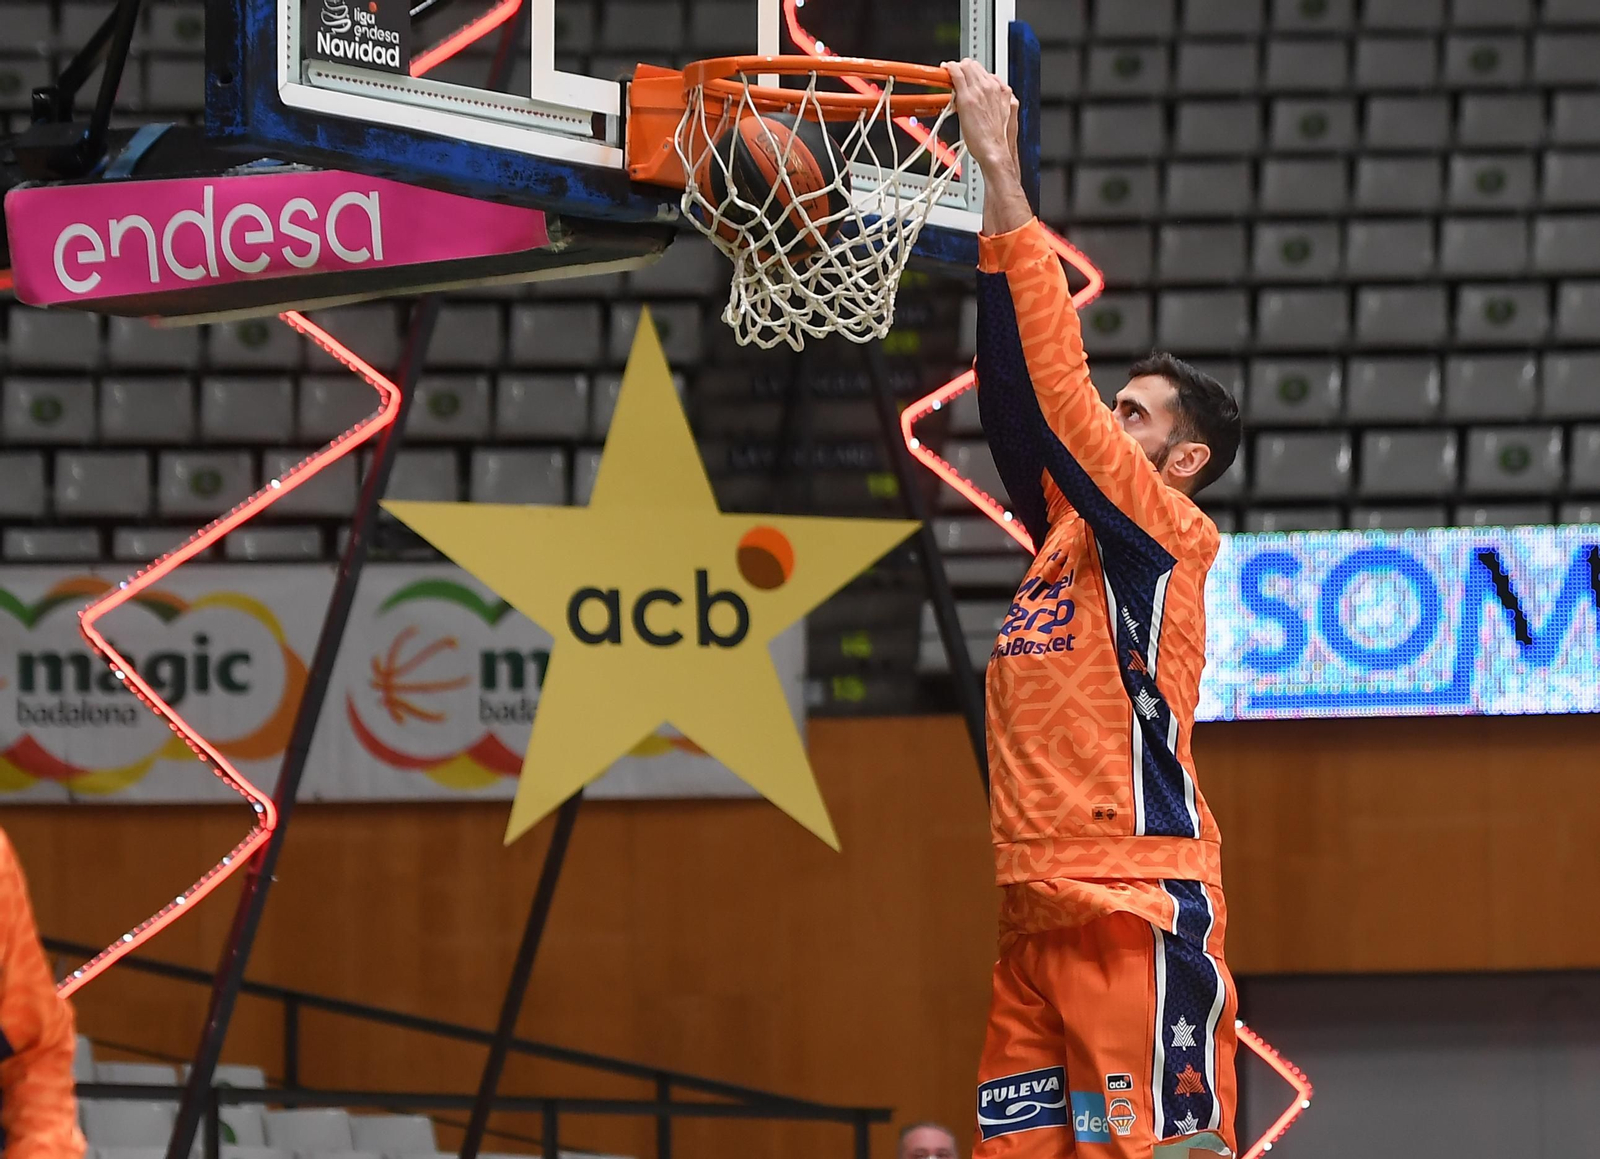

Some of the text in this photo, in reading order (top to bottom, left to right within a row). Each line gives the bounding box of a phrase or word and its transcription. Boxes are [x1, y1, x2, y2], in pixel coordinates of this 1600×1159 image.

[353, 7, 376, 26] liga
[353, 24, 400, 44] endesa
[317, 31, 400, 68] Navidad
[53, 185, 384, 293] endesa
[566, 568, 751, 648] acb
[16, 698, 138, 727] badalona
[981, 1076, 1060, 1108] PULEVA
[1109, 1079, 1127, 1089] acb
